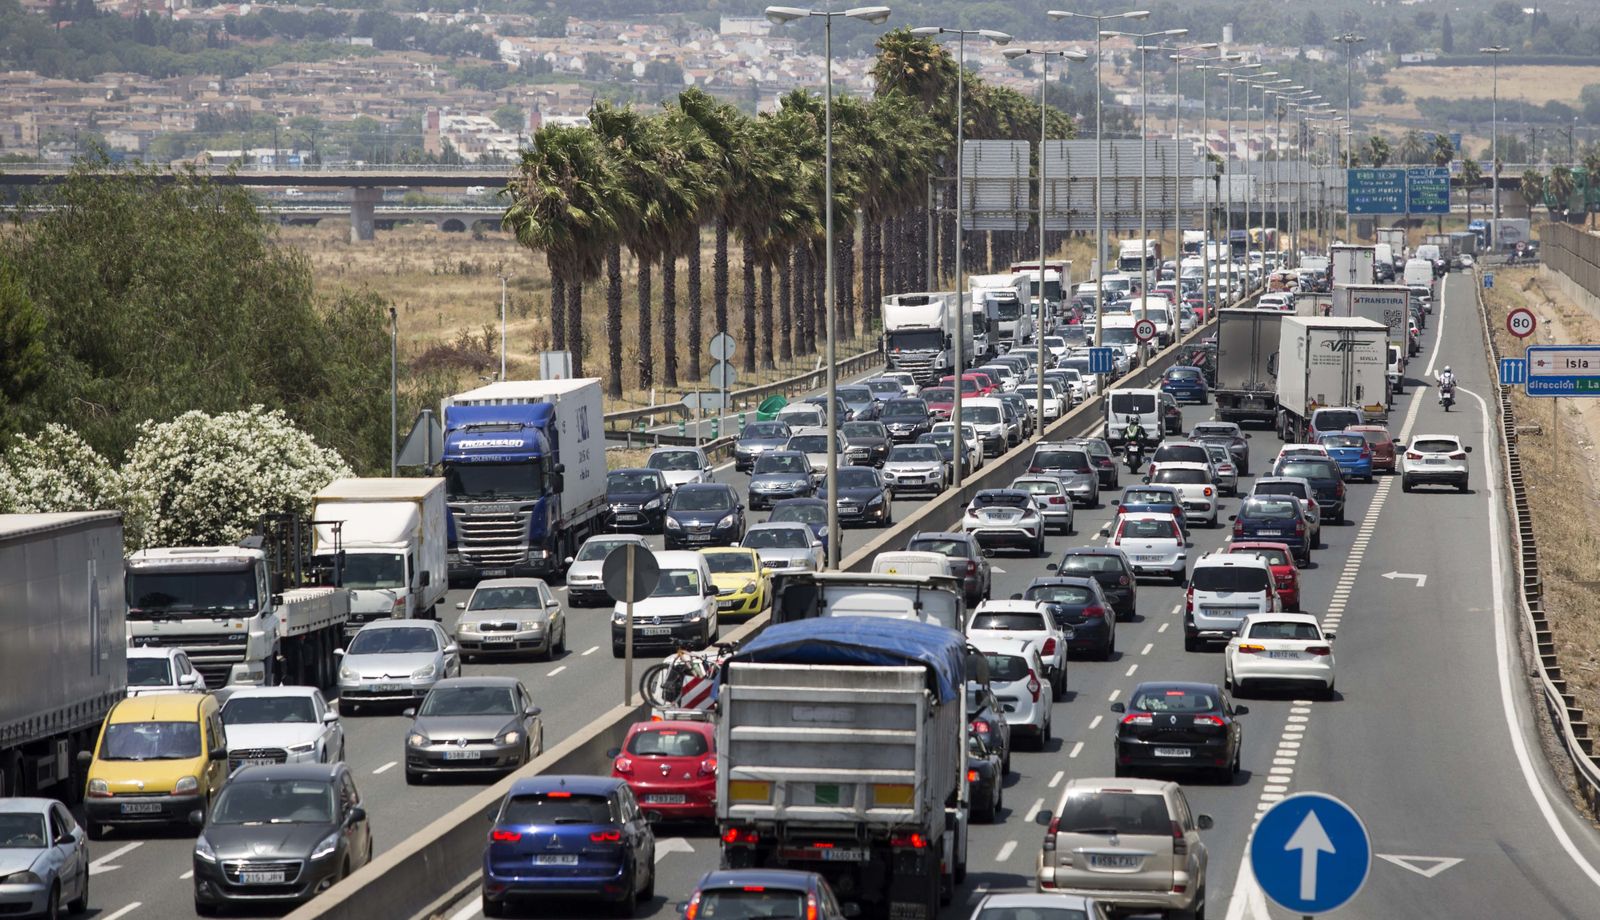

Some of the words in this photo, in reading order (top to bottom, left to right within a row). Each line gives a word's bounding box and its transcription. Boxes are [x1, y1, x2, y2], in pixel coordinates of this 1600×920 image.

[1513, 318, 1530, 328] 80
[1139, 326, 1151, 335] 80
[1566, 358, 1589, 368] Isla
[1529, 380, 1574, 389] dirección
